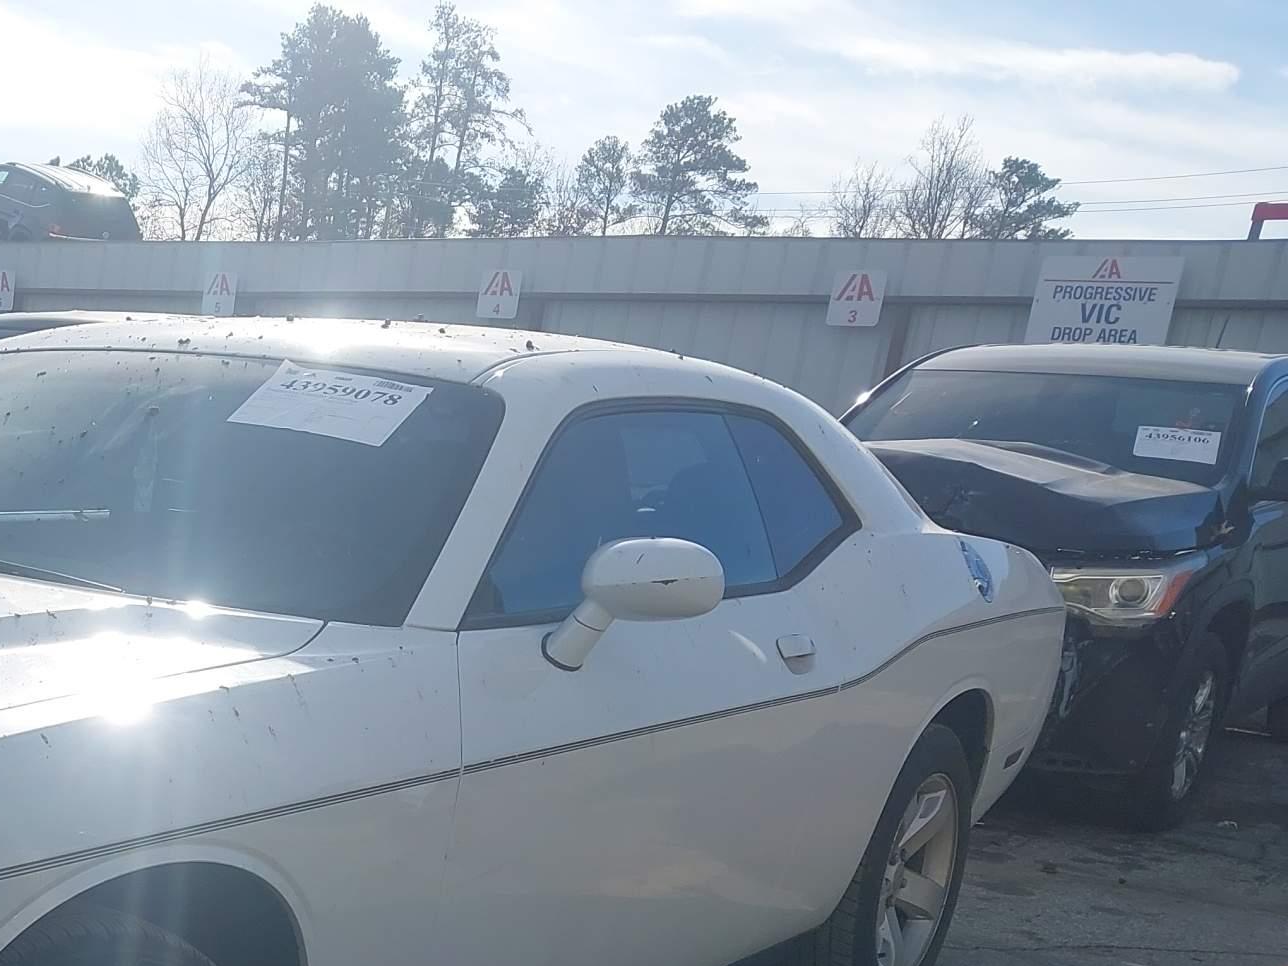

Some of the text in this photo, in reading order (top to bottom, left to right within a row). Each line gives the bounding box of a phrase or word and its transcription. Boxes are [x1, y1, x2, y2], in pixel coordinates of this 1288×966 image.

[1052, 285, 1158, 302] PROGRESSIVE
[492, 303, 500, 315] 4
[847, 310, 858, 323] 3
[1080, 302, 1122, 325] VIC
[1050, 326, 1137, 344] DROP AREA
[280, 379, 402, 406] 43959078
